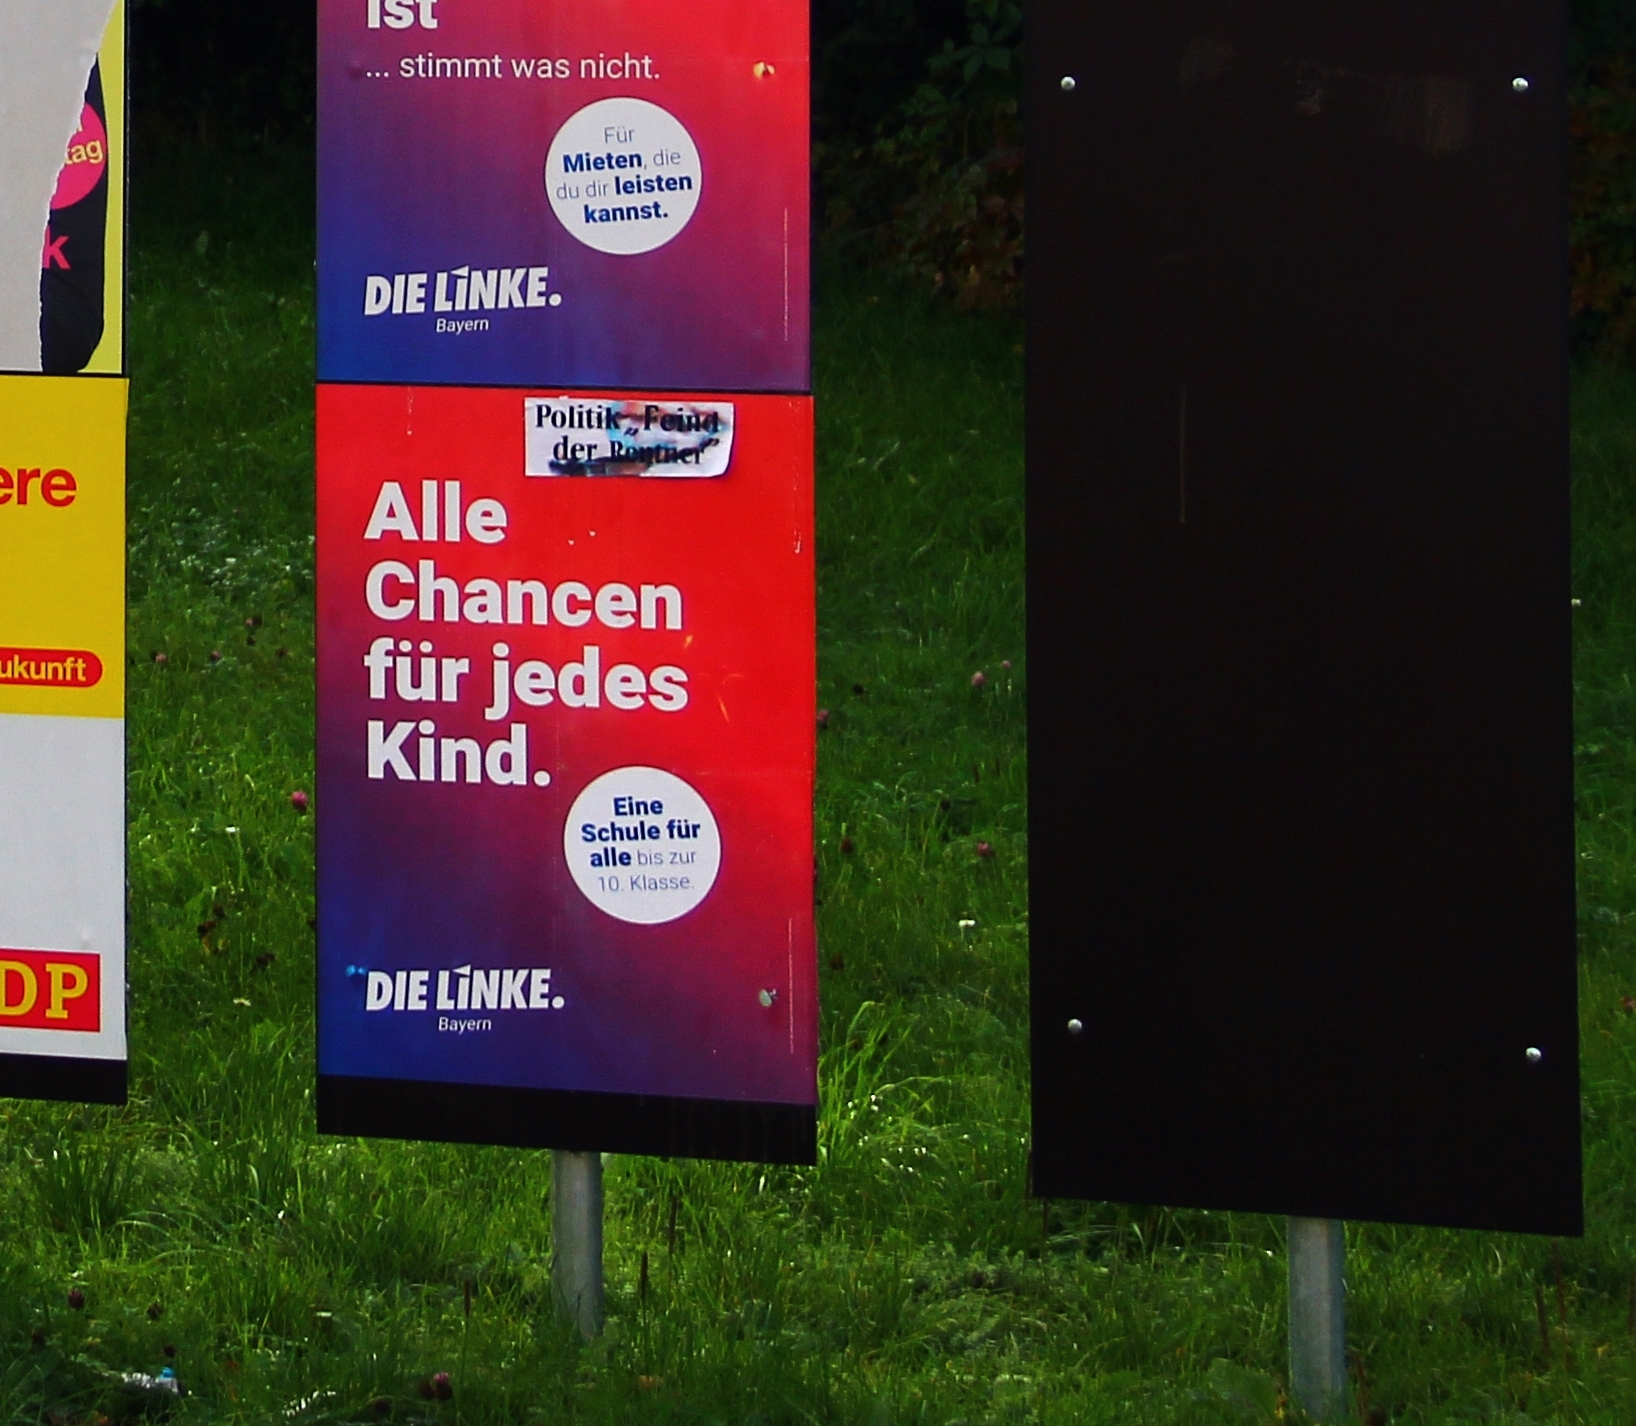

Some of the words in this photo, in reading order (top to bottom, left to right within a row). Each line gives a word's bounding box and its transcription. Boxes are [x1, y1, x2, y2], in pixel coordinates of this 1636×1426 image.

[400, 52, 502, 79] stimmt
[511, 59, 570, 79] was
[580, 53, 661, 79] nicht.
[604, 124, 635, 144] Für
[563, 151, 648, 173] Mieten,
[653, 148, 681, 167] die
[614, 172, 693, 195] leisten
[583, 199, 669, 223] kannst.
[364, 479, 507, 543] Alle
[365, 560, 683, 631] Chancen
[364, 638, 470, 703] für
[484, 644, 689, 721] jedes
[366, 719, 551, 788] Kind.
[613, 795, 664, 817] Eine
[581, 821, 661, 844] Schule
[666, 818, 701, 841] für
[589, 844, 632, 869] alle
[637, 848, 664, 868] bis
[669, 850, 696, 867] zur
[598, 873, 623, 893] 10.
[629, 871, 695, 892] Klasse.
